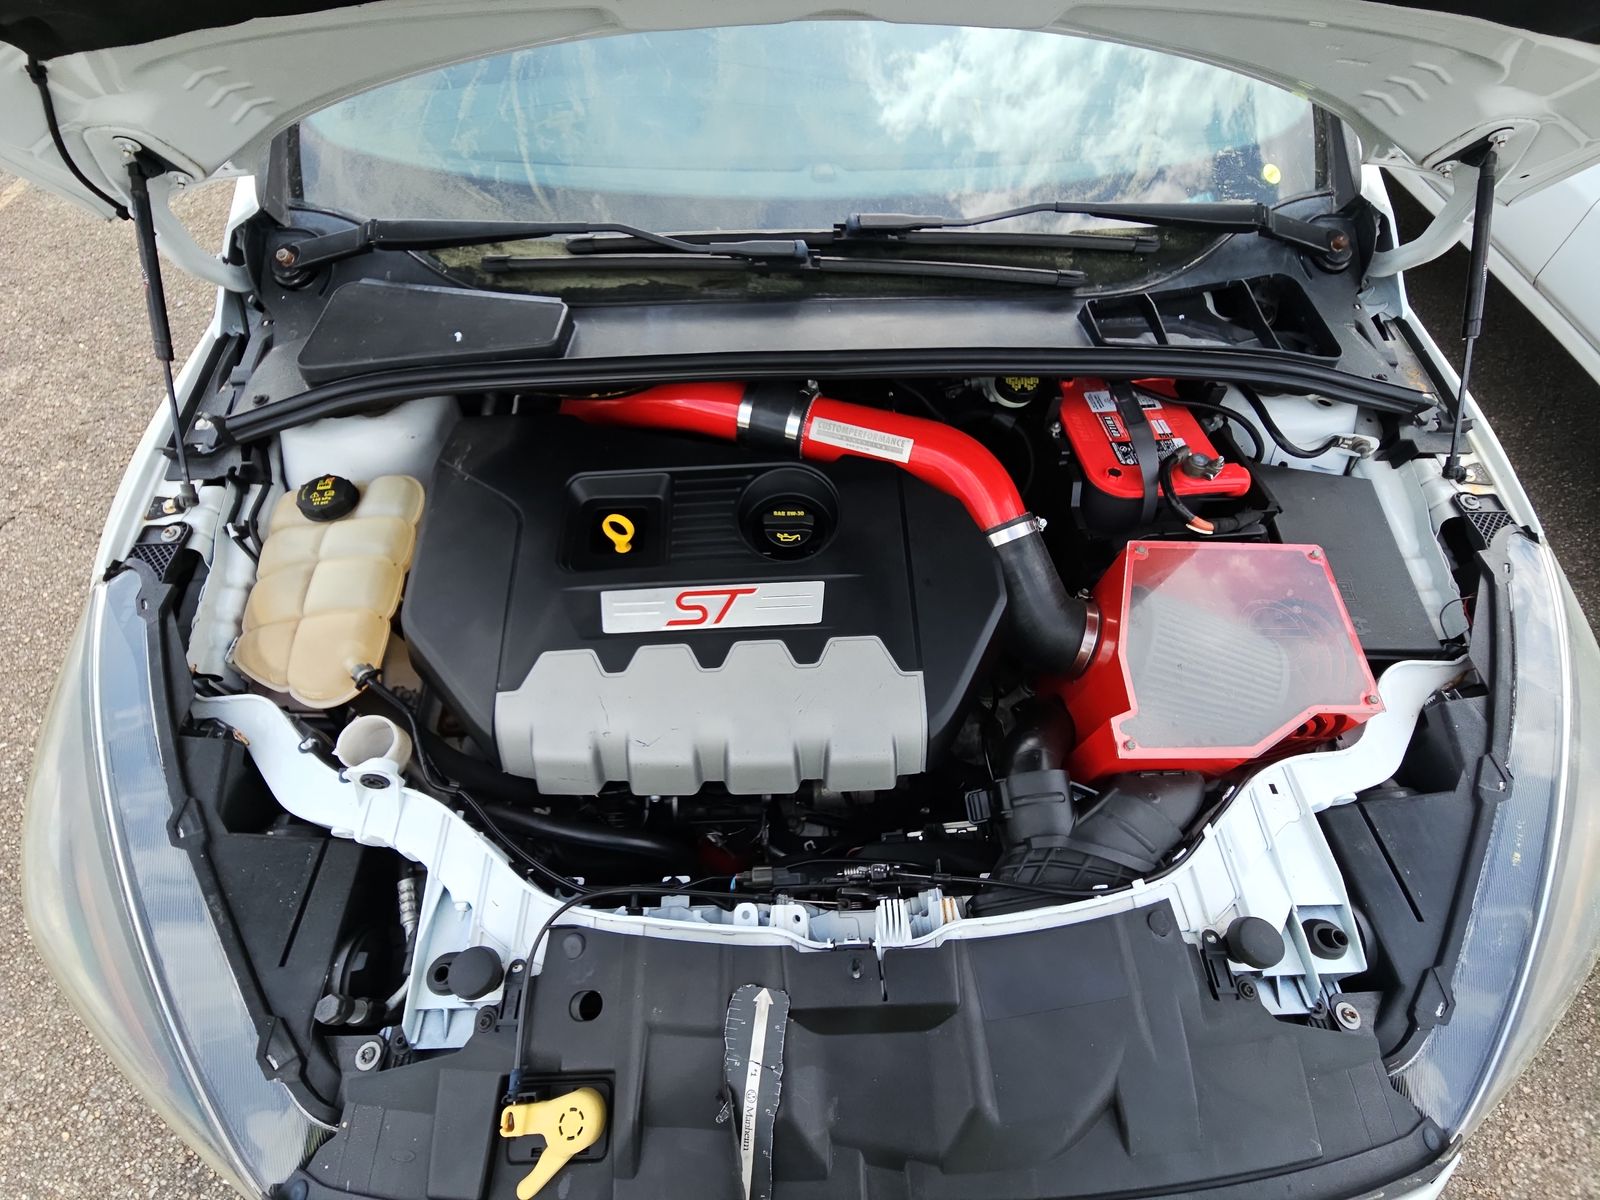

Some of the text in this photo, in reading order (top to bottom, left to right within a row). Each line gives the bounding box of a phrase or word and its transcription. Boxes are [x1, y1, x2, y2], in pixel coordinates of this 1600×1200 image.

[817, 421, 906, 448] CUSTOMPERFORMANCE
[665, 587, 759, 627] ST
[743, 1105, 755, 1151] Manheim
